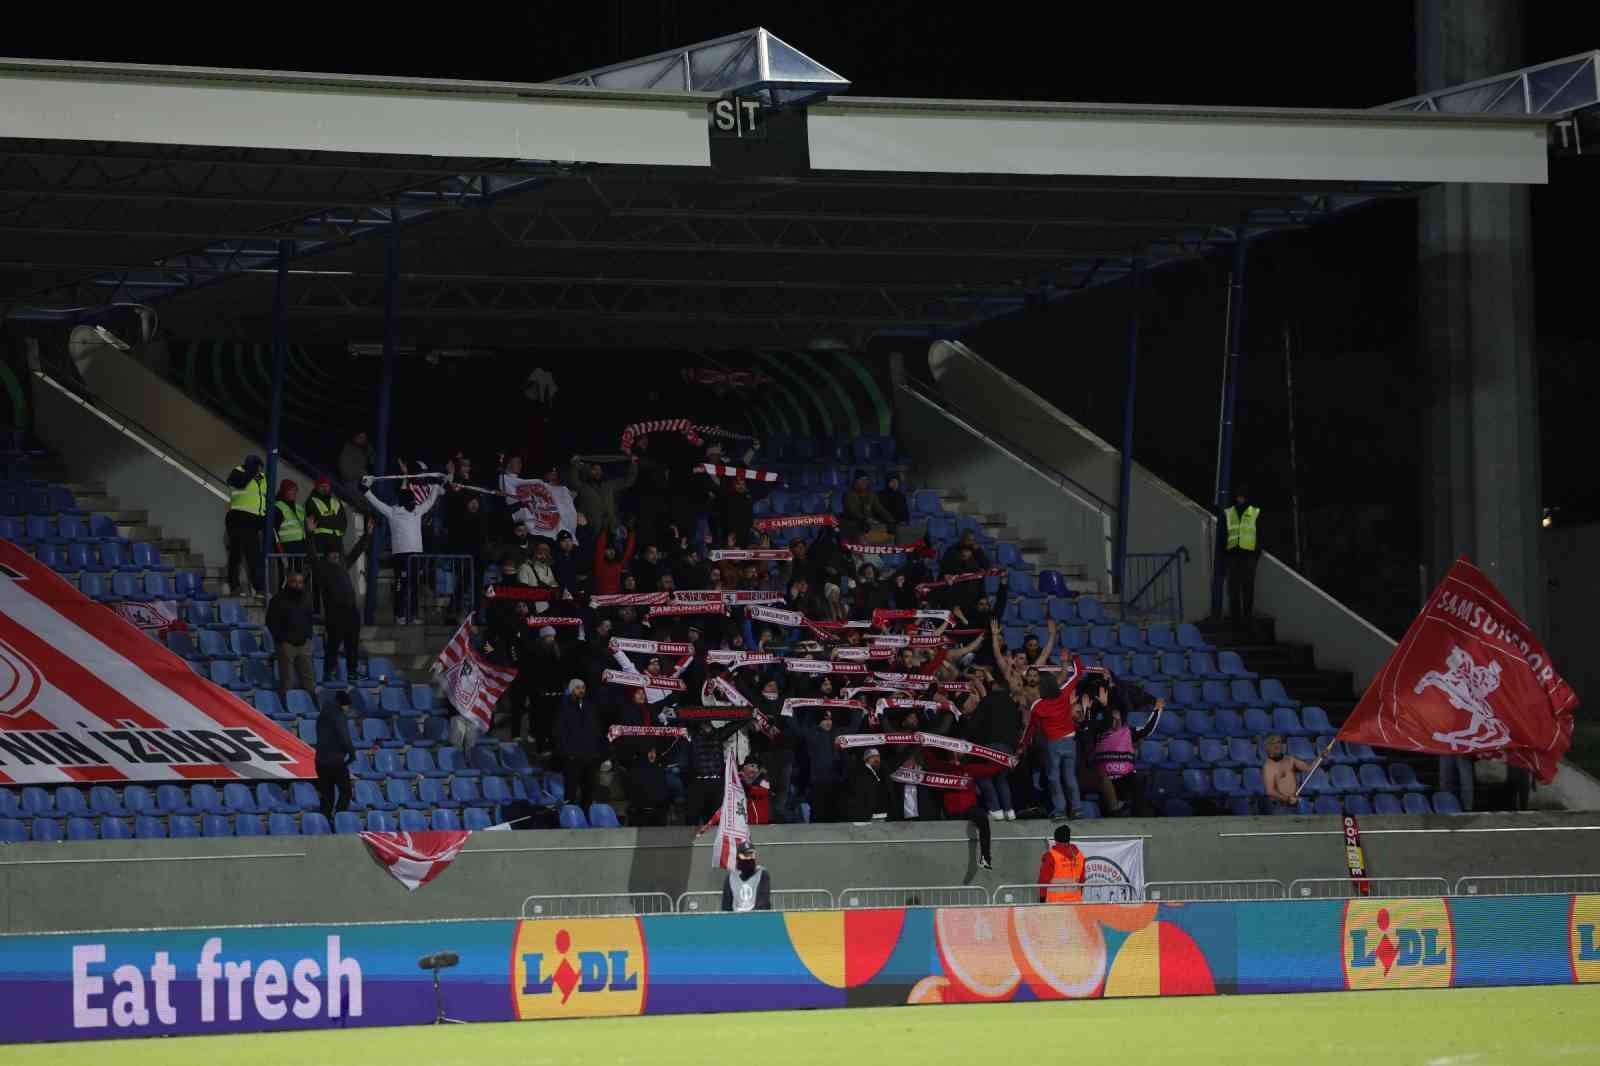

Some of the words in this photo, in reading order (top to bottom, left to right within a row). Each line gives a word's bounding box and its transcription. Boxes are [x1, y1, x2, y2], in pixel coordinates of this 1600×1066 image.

[771, 518, 825, 529] SAMSUNSPOR
[660, 643, 687, 652] GERMANY
[887, 734, 912, 742] GERMANY
[926, 774, 960, 786] GERMANY
[72, 943, 176, 1028] Eat
[196, 935, 363, 1022] fresh
